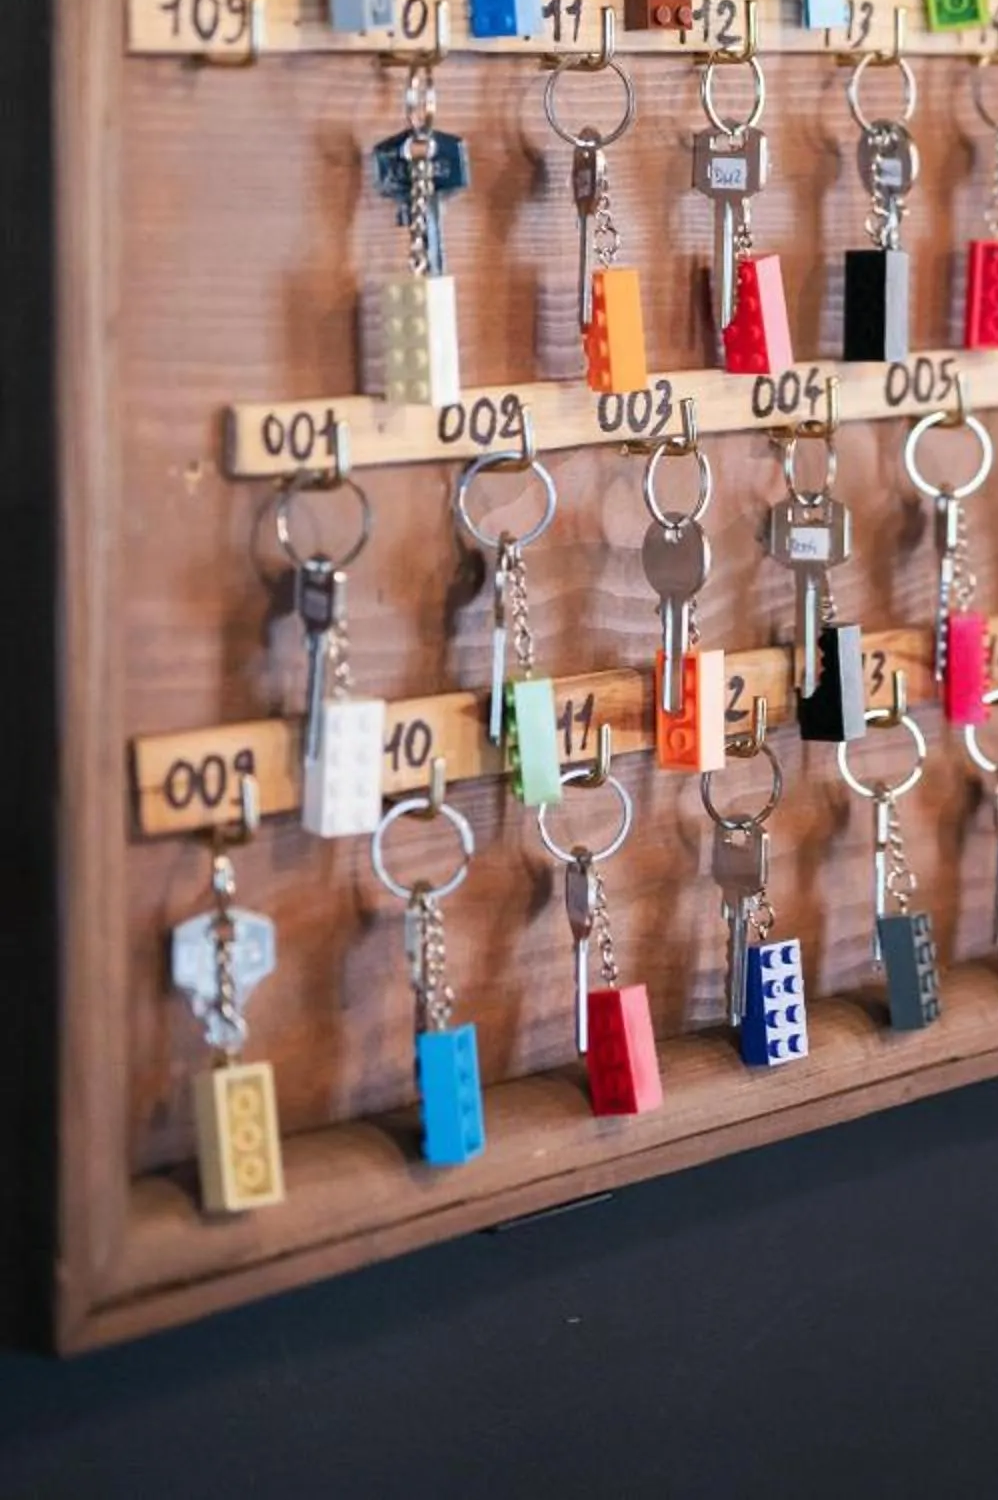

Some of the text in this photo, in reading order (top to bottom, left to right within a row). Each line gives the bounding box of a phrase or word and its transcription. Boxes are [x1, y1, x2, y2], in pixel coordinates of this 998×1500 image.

[751, 366, 824, 418] 004
[885, 356, 956, 407] 005
[438, 393, 522, 445] 002
[597, 379, 672, 437] 003
[262, 409, 337, 460] 001
[384, 719, 432, 771] 10
[556, 693, 595, 756] 11
